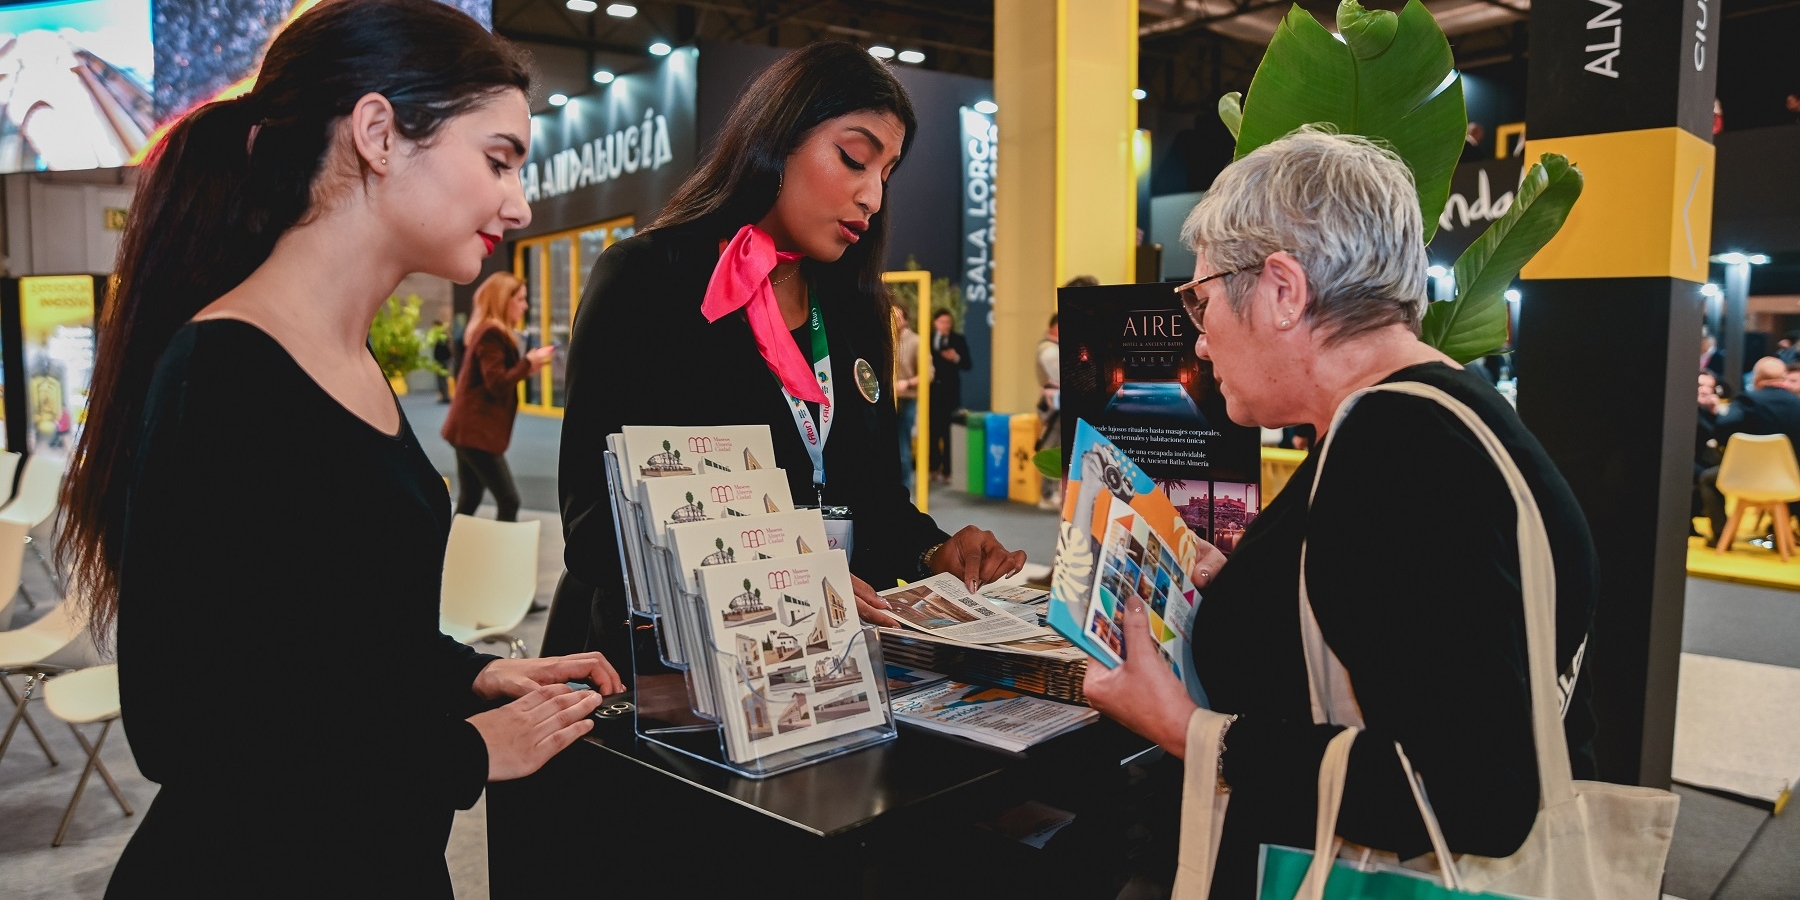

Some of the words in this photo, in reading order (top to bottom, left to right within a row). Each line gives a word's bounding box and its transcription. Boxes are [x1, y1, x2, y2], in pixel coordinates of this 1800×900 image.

[1694, 0, 1708, 72] CIU
[966, 227, 988, 302] SALA
[1123, 314, 1183, 338] AIRE
[1122, 355, 1185, 363] ALMERÍA
[1107, 425, 1128, 434] lujosos
[1127, 426, 1149, 434] rituales
[1149, 427, 1165, 435] hasta
[1165, 428, 1188, 437] masajes
[1188, 429, 1222, 438] corporales,
[1121, 434, 1145, 442] termales
[1150, 435, 1186, 444] habitaciones
[1186, 436, 1206, 444] únicas
[1147, 449, 1174, 458] escapada
[1174, 450, 1207, 459] inolvidable
[1146, 457, 1169, 465] Ancient
[1169, 458, 1185, 466] Baths
[1185, 459, 1209, 467] Almería
